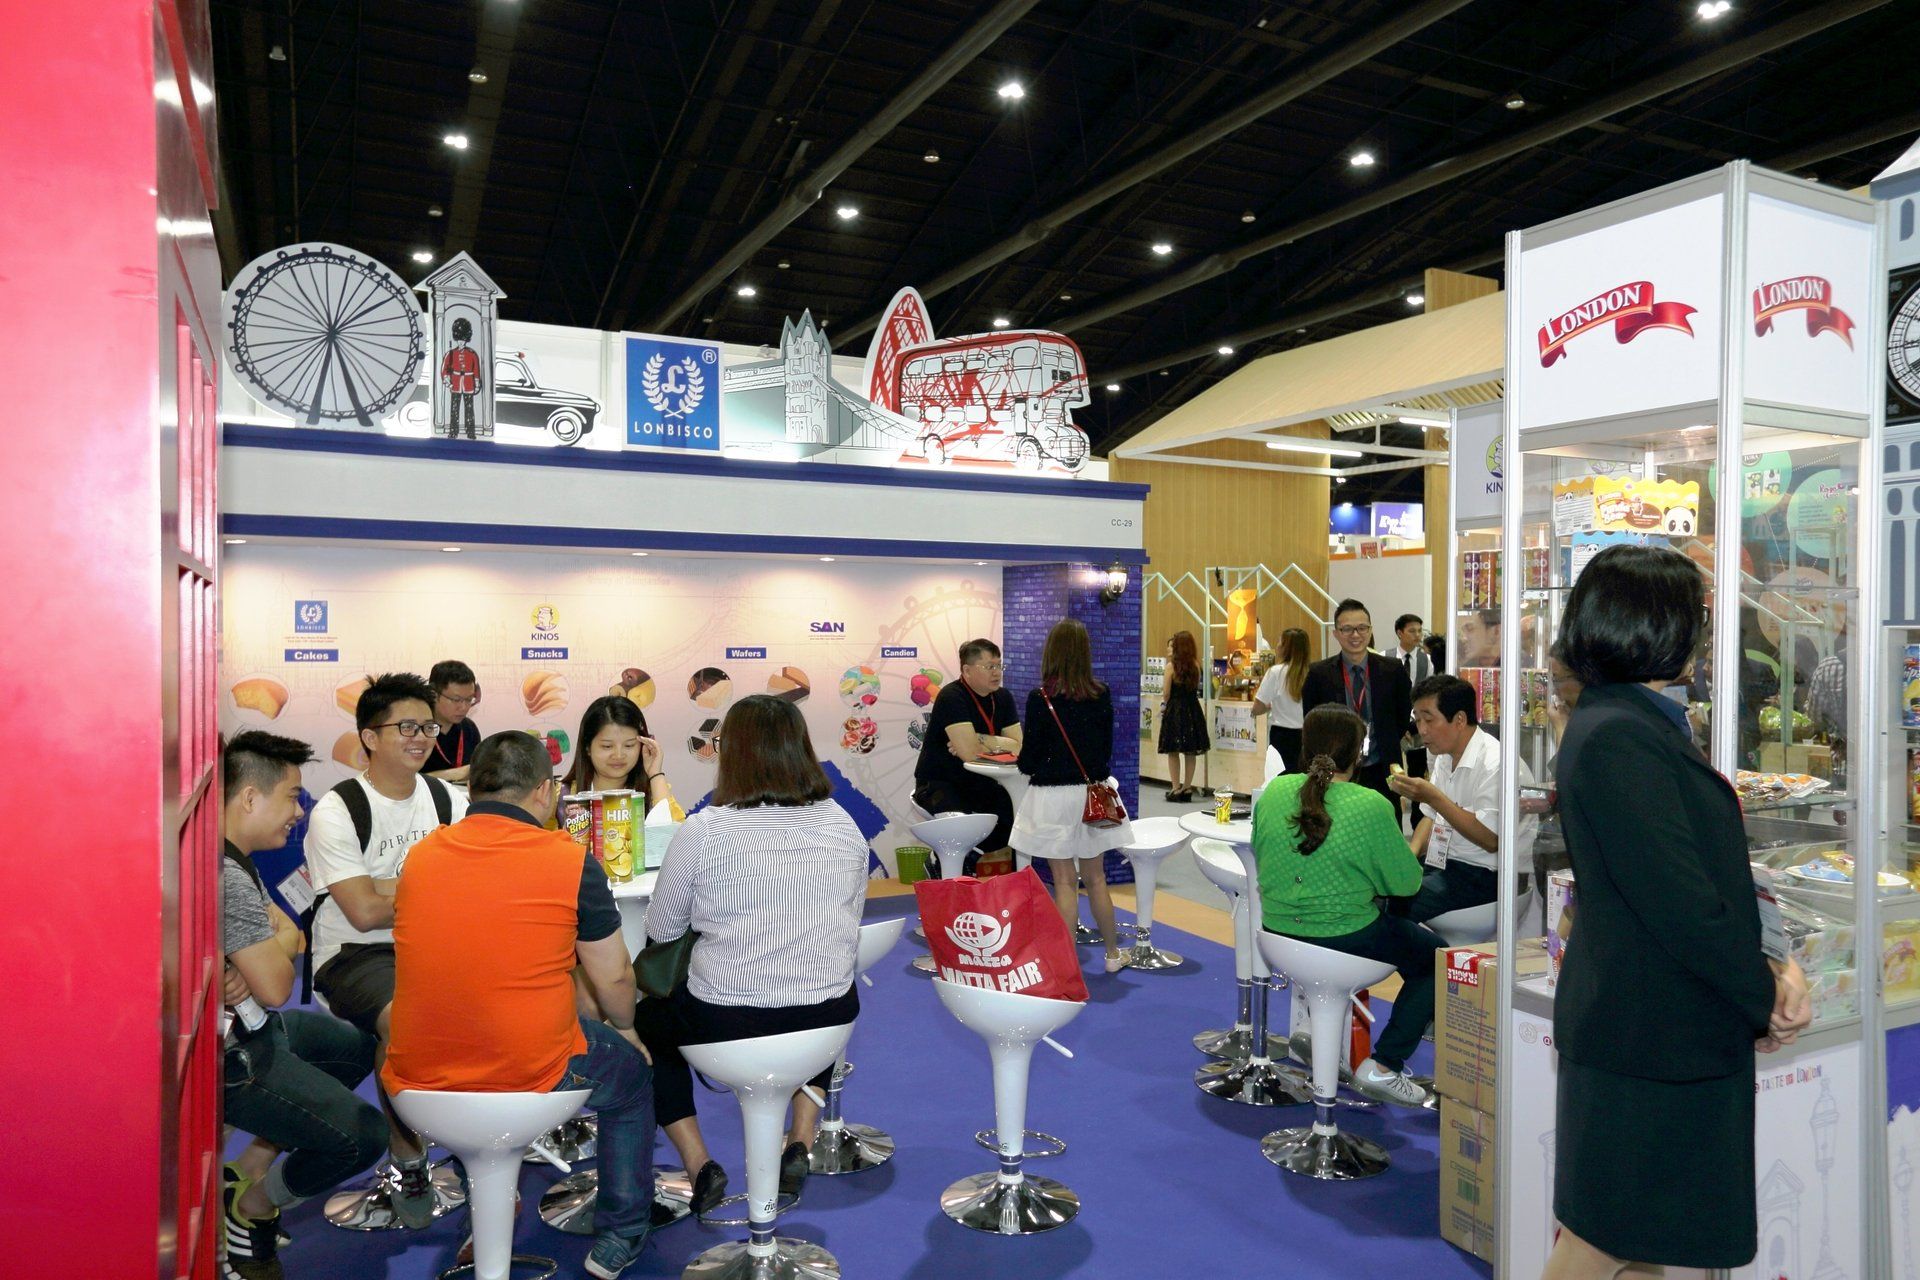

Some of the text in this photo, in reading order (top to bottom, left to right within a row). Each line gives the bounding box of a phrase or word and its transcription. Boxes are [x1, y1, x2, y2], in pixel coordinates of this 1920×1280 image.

[1758, 278, 1825, 312] LONDON
[1543, 285, 1642, 345] LONDON
[633, 421, 713, 439] LONBISCO
[1486, 482, 1503, 494] KIN
[1111, 518, 1133, 528] CC-29
[810, 621, 845, 633] SAN
[531, 632, 560, 641] KINOS
[294, 651, 329, 660] Cakes
[527, 649, 564, 659] Snacks
[731, 649, 761, 658] Wafers
[884, 649, 915, 657] Candies
[606, 809, 632, 821] HIR
[379, 829, 436, 857] PIRTE
[941, 961, 1043, 993] MATTA FAIR
